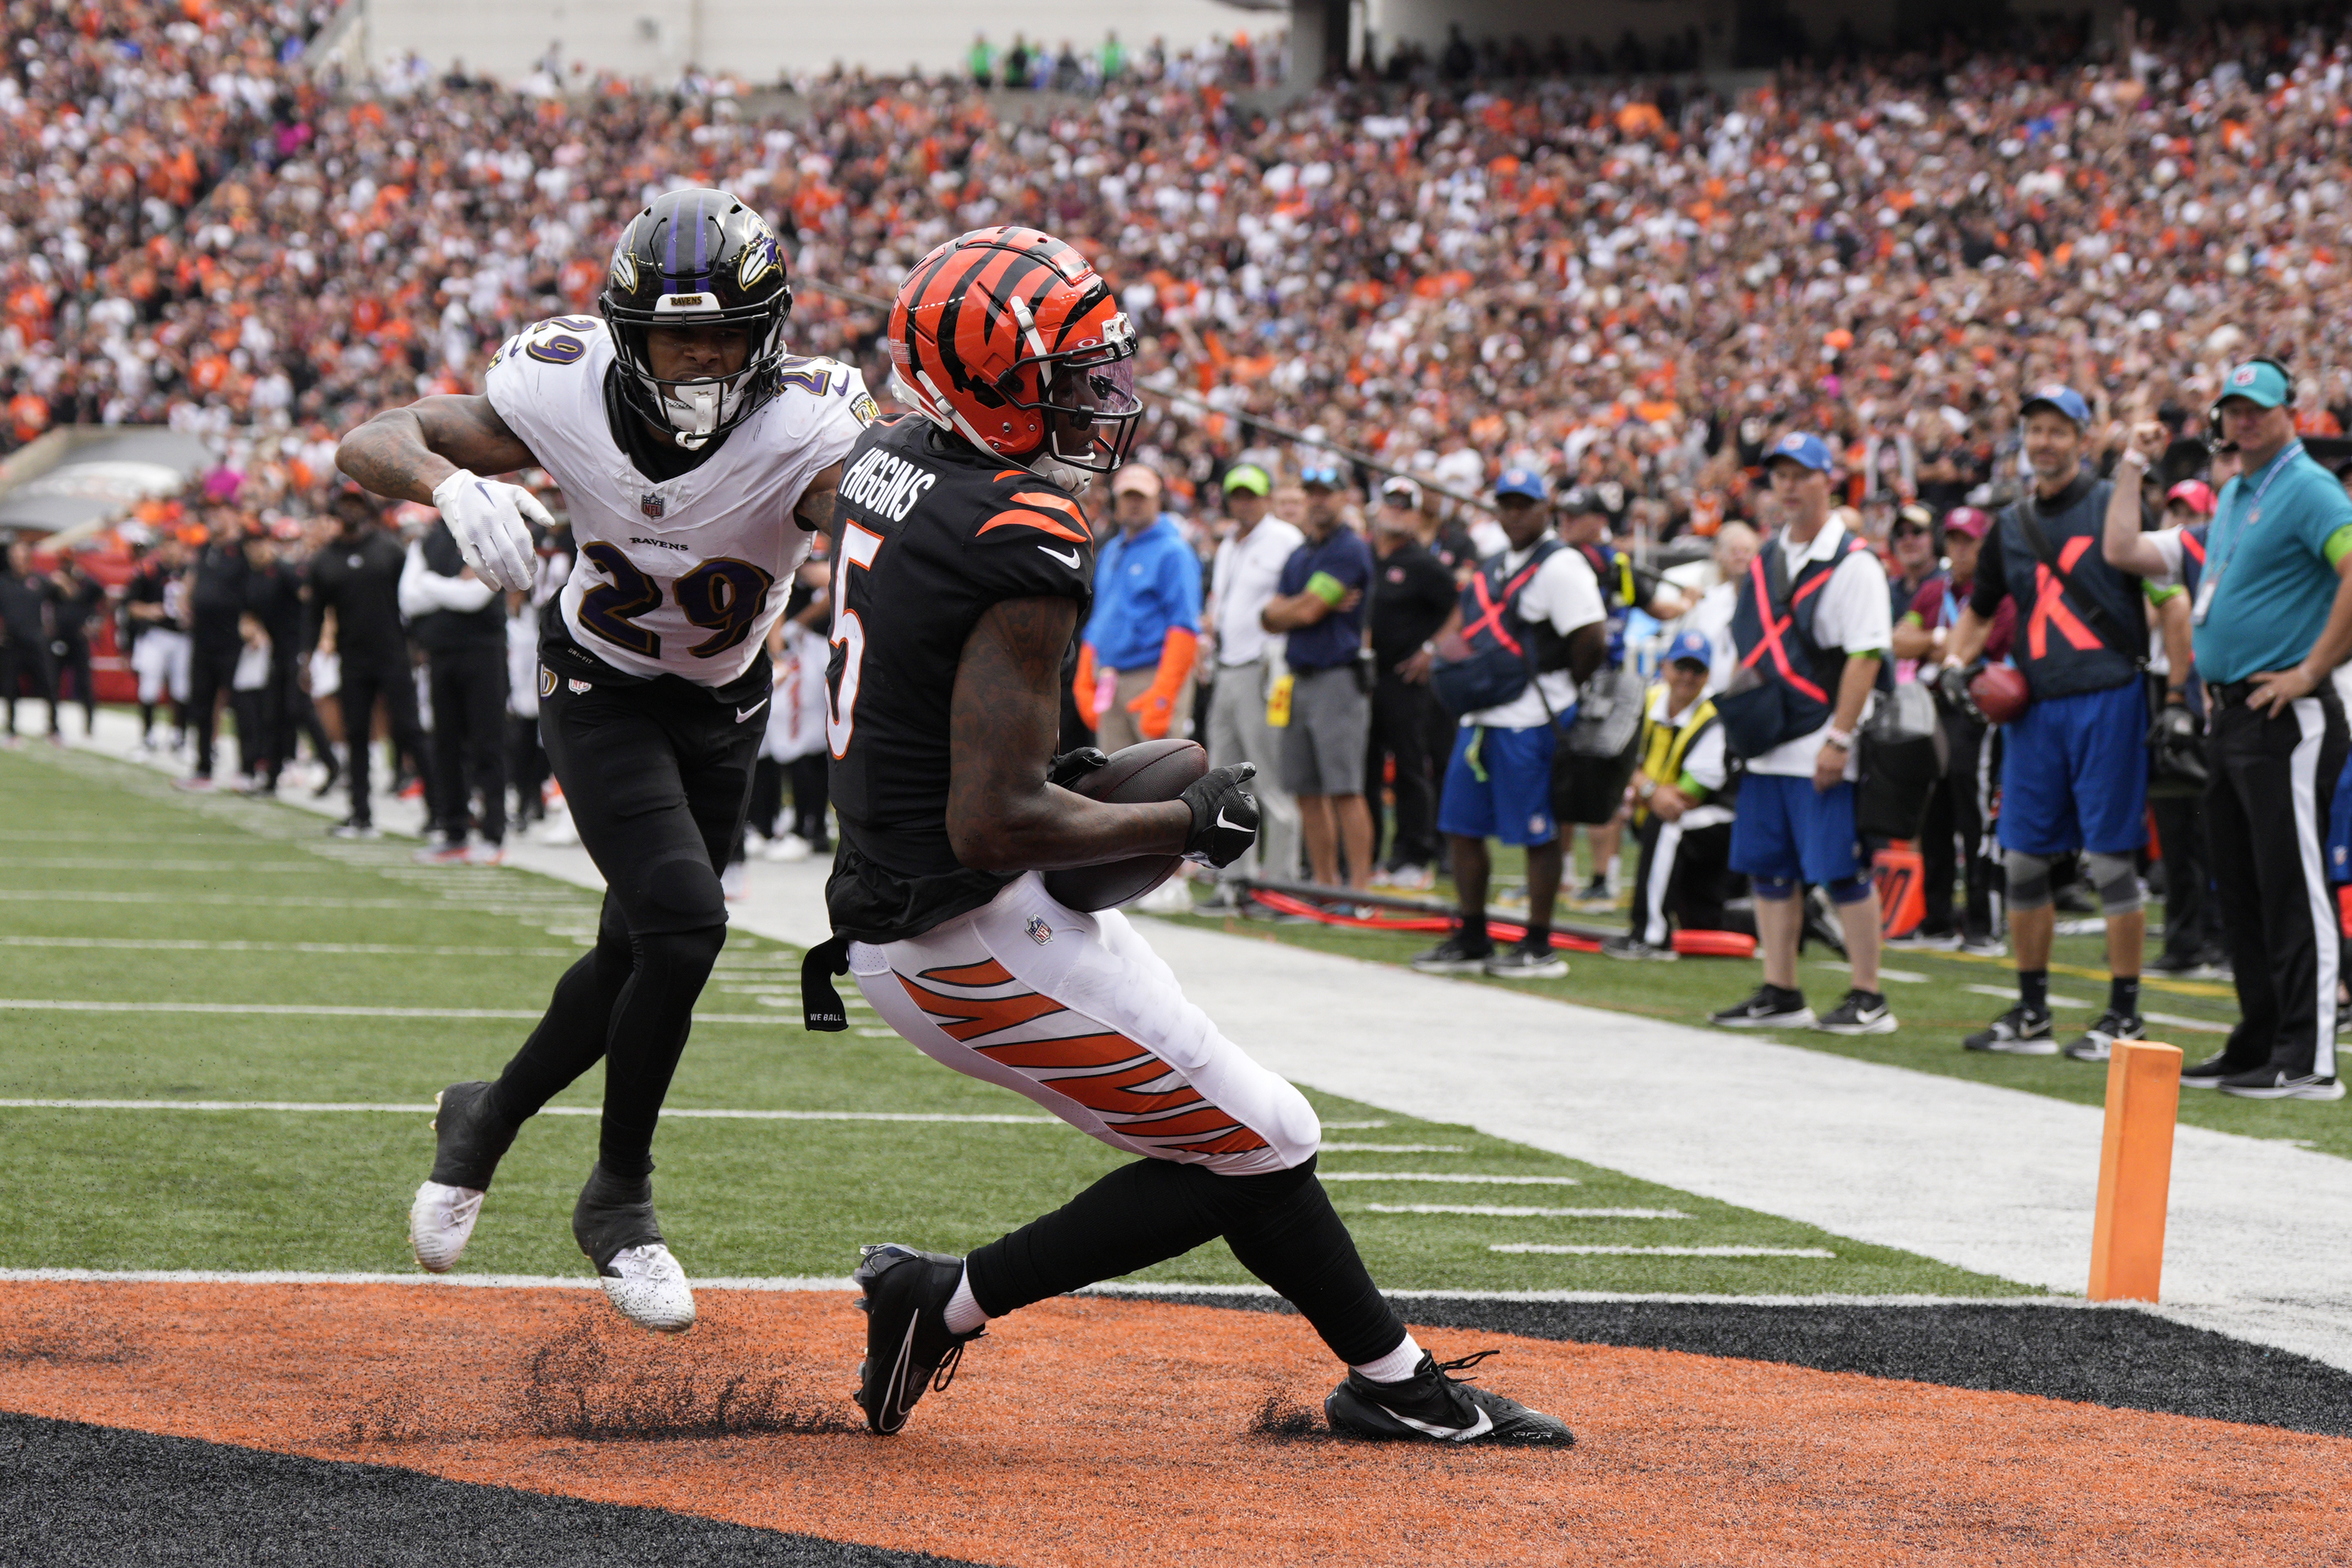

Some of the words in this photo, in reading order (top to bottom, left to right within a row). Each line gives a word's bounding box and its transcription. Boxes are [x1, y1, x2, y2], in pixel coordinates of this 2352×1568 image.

[670, 296, 702, 306] RAVENS
[526, 317, 598, 365] 29
[839, 447, 936, 522] HIGGINS
[645, 504, 661, 516] NFL
[629, 537, 689, 551] RAVENS
[577, 540, 775, 659] 29
[2027, 535, 2105, 660] K
[824, 518, 885, 761] 5
[567, 647, 594, 665] DRI-FIT
[573, 679, 589, 689] NFL
[1035, 925, 1050, 941] NFL
[810, 1013, 822, 1021] WE
